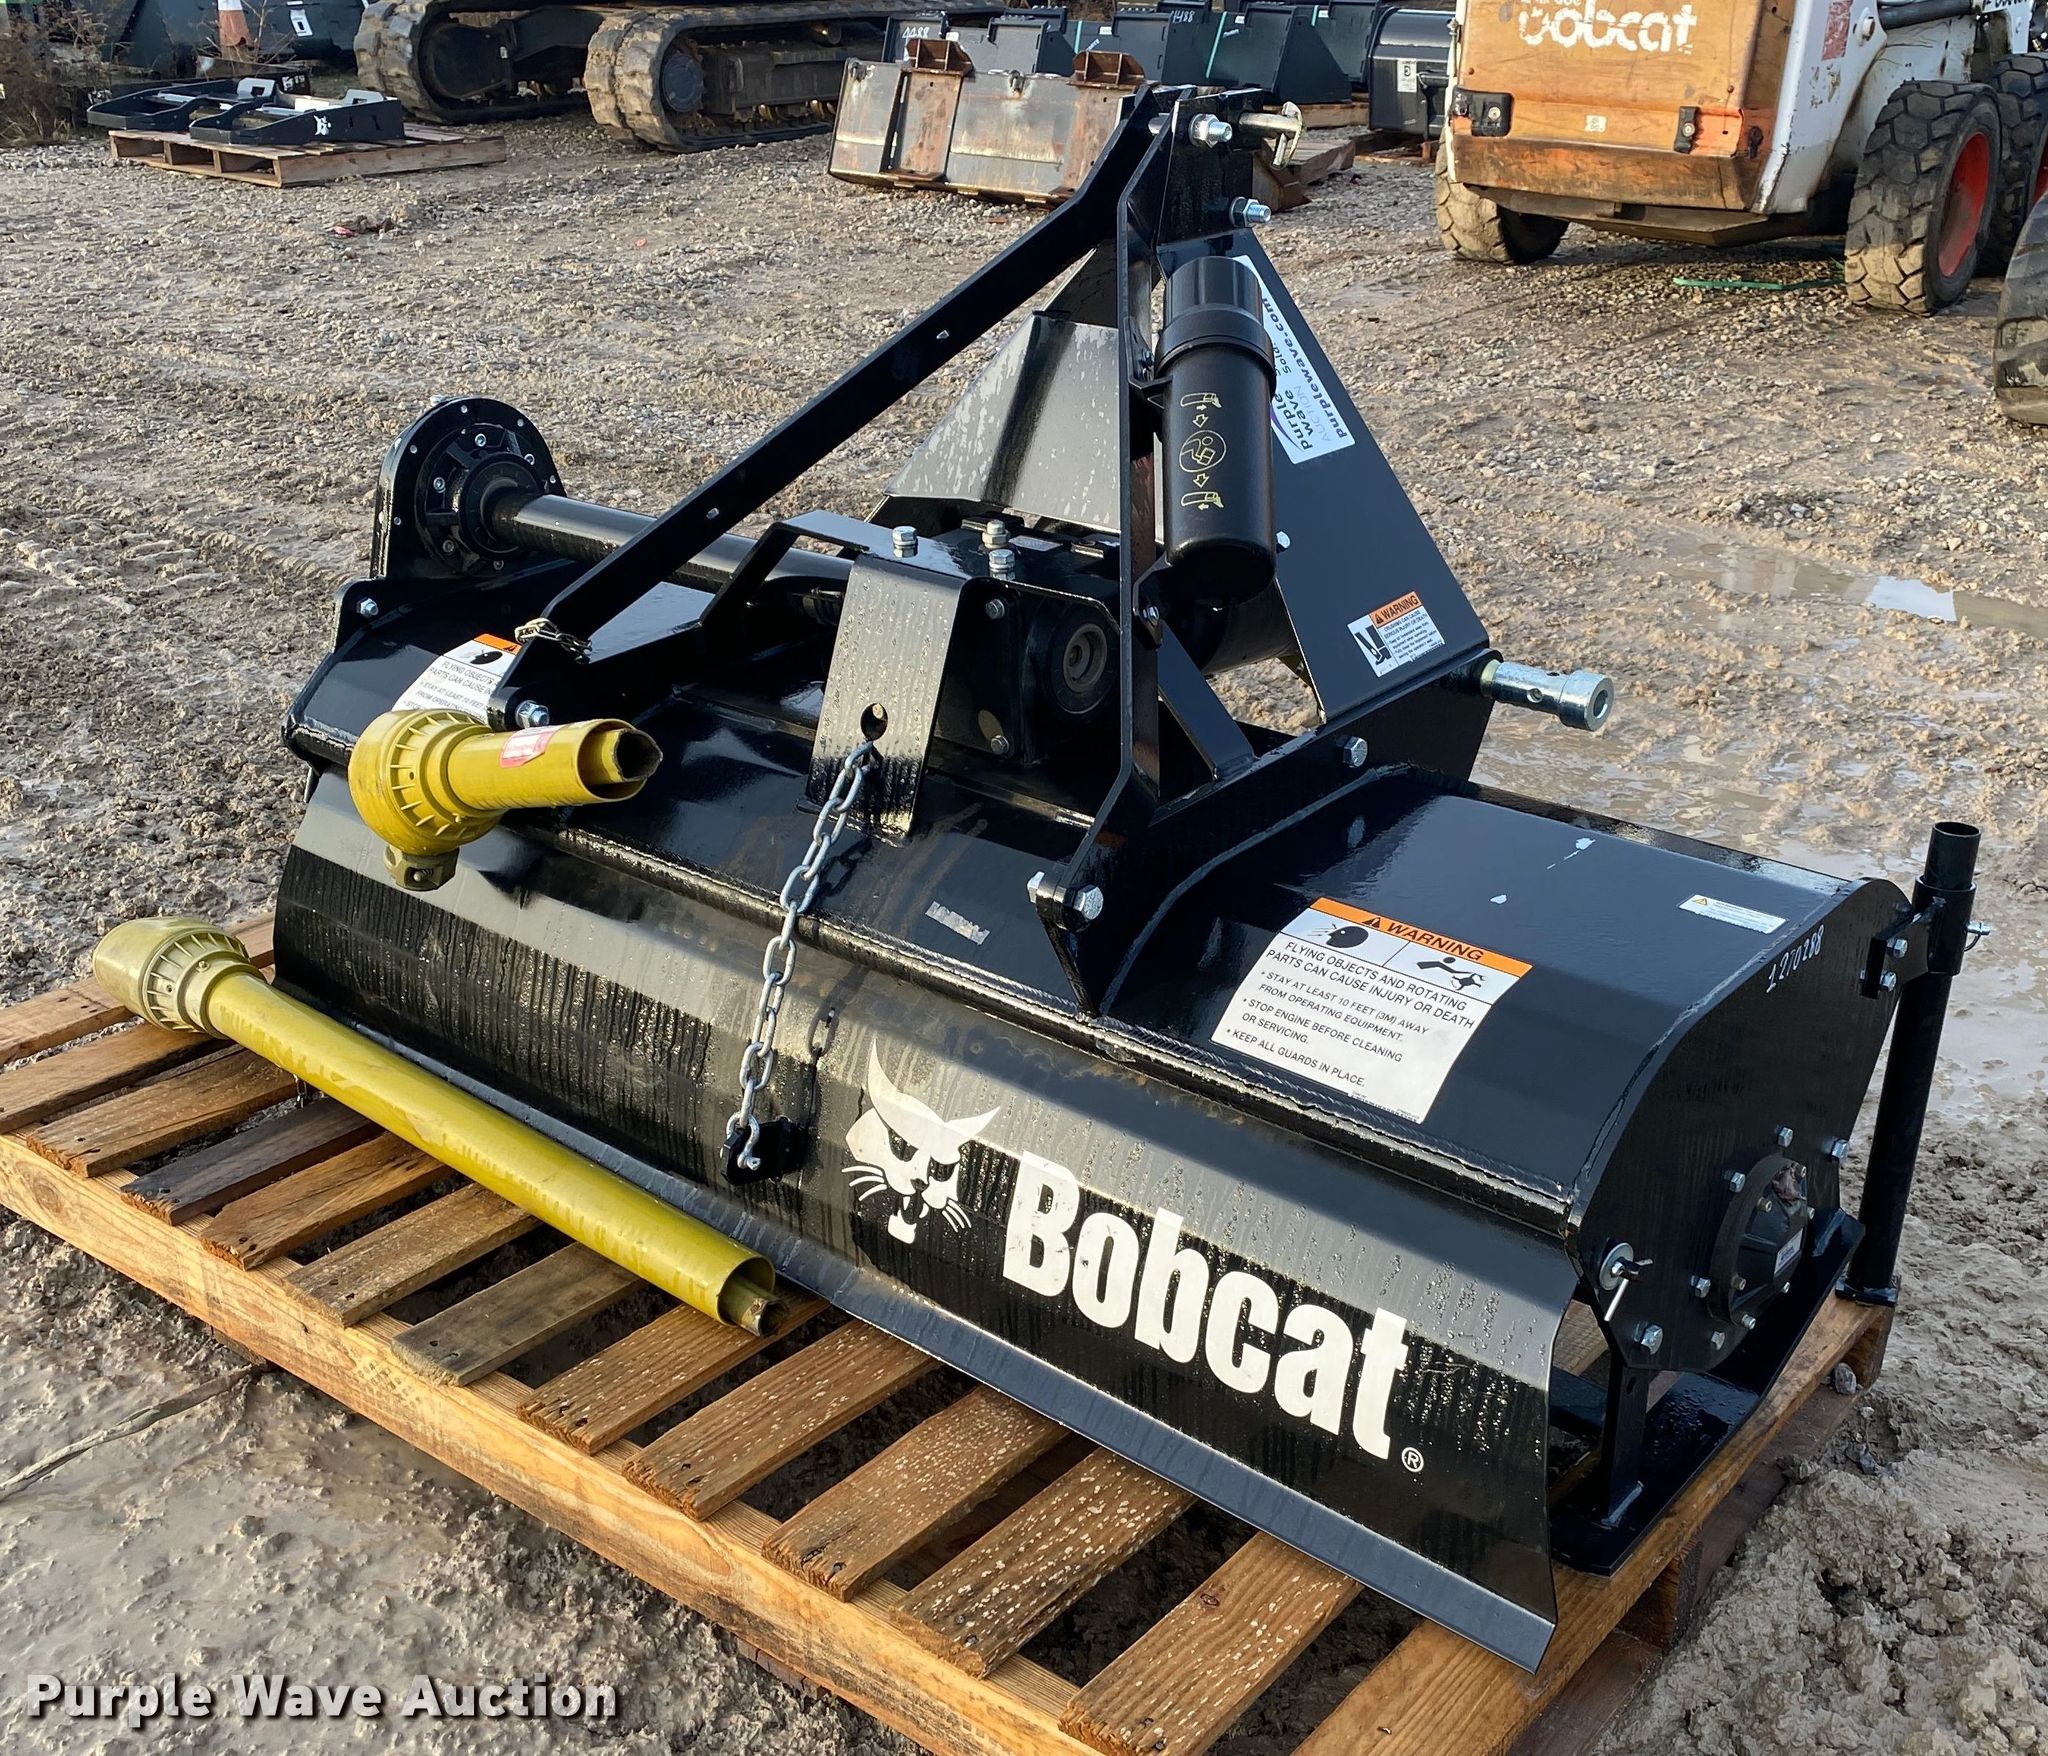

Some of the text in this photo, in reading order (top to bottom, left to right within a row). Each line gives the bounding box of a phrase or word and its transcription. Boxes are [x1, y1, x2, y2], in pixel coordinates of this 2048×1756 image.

[1262, 297, 1348, 439] purplewave.com
[1274, 393, 1313, 450] purple
[1285, 389, 1314, 436] wave
[1294, 385, 1331, 442] AUCTION
[1381, 595, 1419, 620] WARNING
[1387, 922, 1484, 961] WARNING
[1258, 983, 1287, 999] FROM
[1288, 994, 1343, 1019] OPERATING
[1265, 949, 1476, 1029] PARTS CAN CAUSE INJURY OR DEATH
[1266, 971, 1430, 1035] STAY AT LEAST 10 FEET (3M) AWAY
[1285, 941, 1467, 1011] FLYING OBJECTS AND ROTATING
[1241, 1012, 1309, 1044] OR SERVICING.
[1248, 999, 1403, 1063] STOP ENGINE BEFORE CLEANING
[1232, 1028, 1365, 1087] KEEP ALL GUARDS IN PLACE.
[1002, 1150, 1409, 1460] Bobcat
